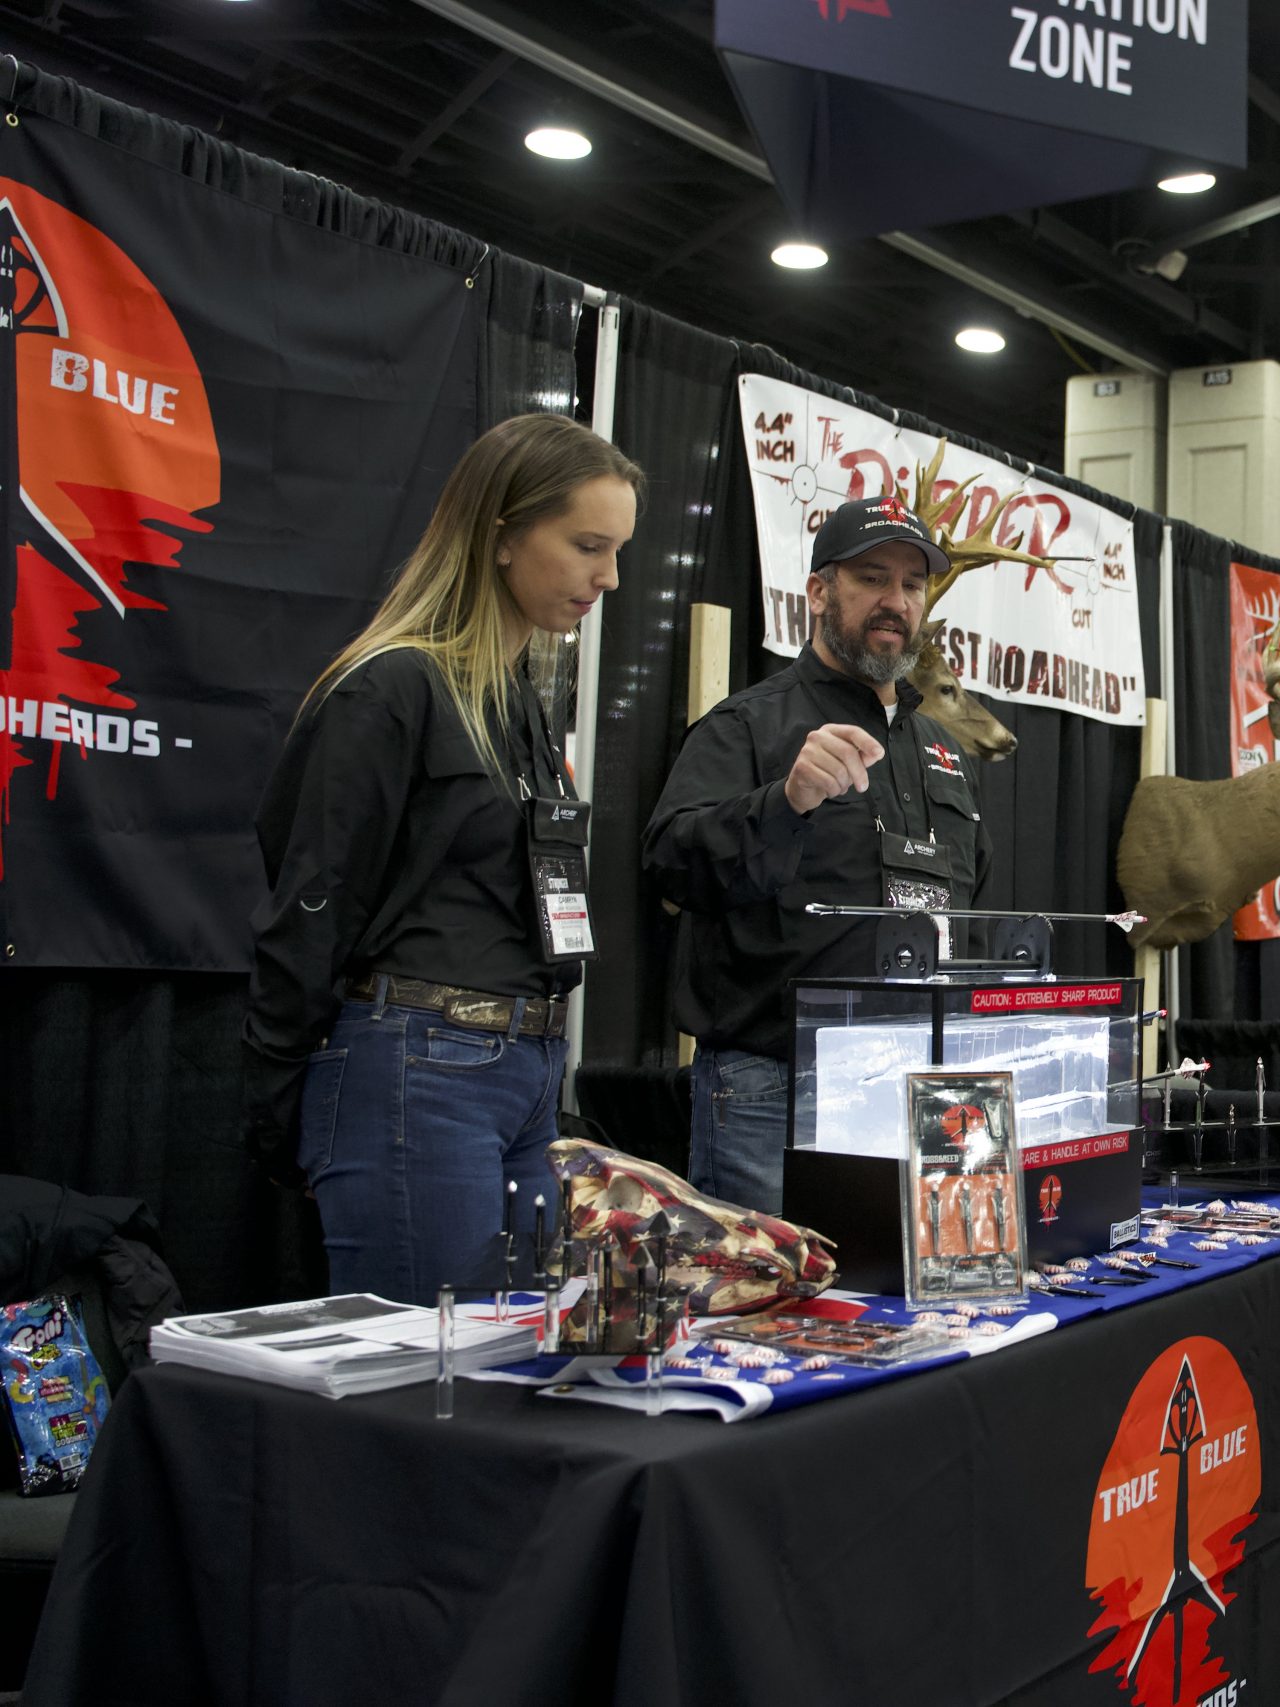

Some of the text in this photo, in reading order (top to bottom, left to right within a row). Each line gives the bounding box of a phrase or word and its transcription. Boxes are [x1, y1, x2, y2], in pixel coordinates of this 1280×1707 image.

[1009, 6, 1134, 96] ZONE
[50, 347, 179, 426] BLUE
[754, 411, 793, 435] 4.4"
[756, 439, 796, 463] INCH
[865, 504, 891, 514] TRUE
[1103, 562, 1126, 581] INCH
[1071, 607, 1092, 629] CUT
[0, 694, 162, 757] HEADS
[973, 987, 1121, 1008] CAUTION: EXTREMELY SHARP PRODUCT
[1042, 1150, 1049, 1162] &
[1051, 1145, 1080, 1160] HANDLE
[1082, 1143, 1092, 1154] AT
[1093, 1140, 1111, 1152] OWN
[1112, 1136, 1128, 1148] RISK
[1114, 1223, 1137, 1239] BALLISTICS
[12, 1311, 63, 1353] Trolli
[1099, 1424, 1248, 1523] TRUE BLUE
